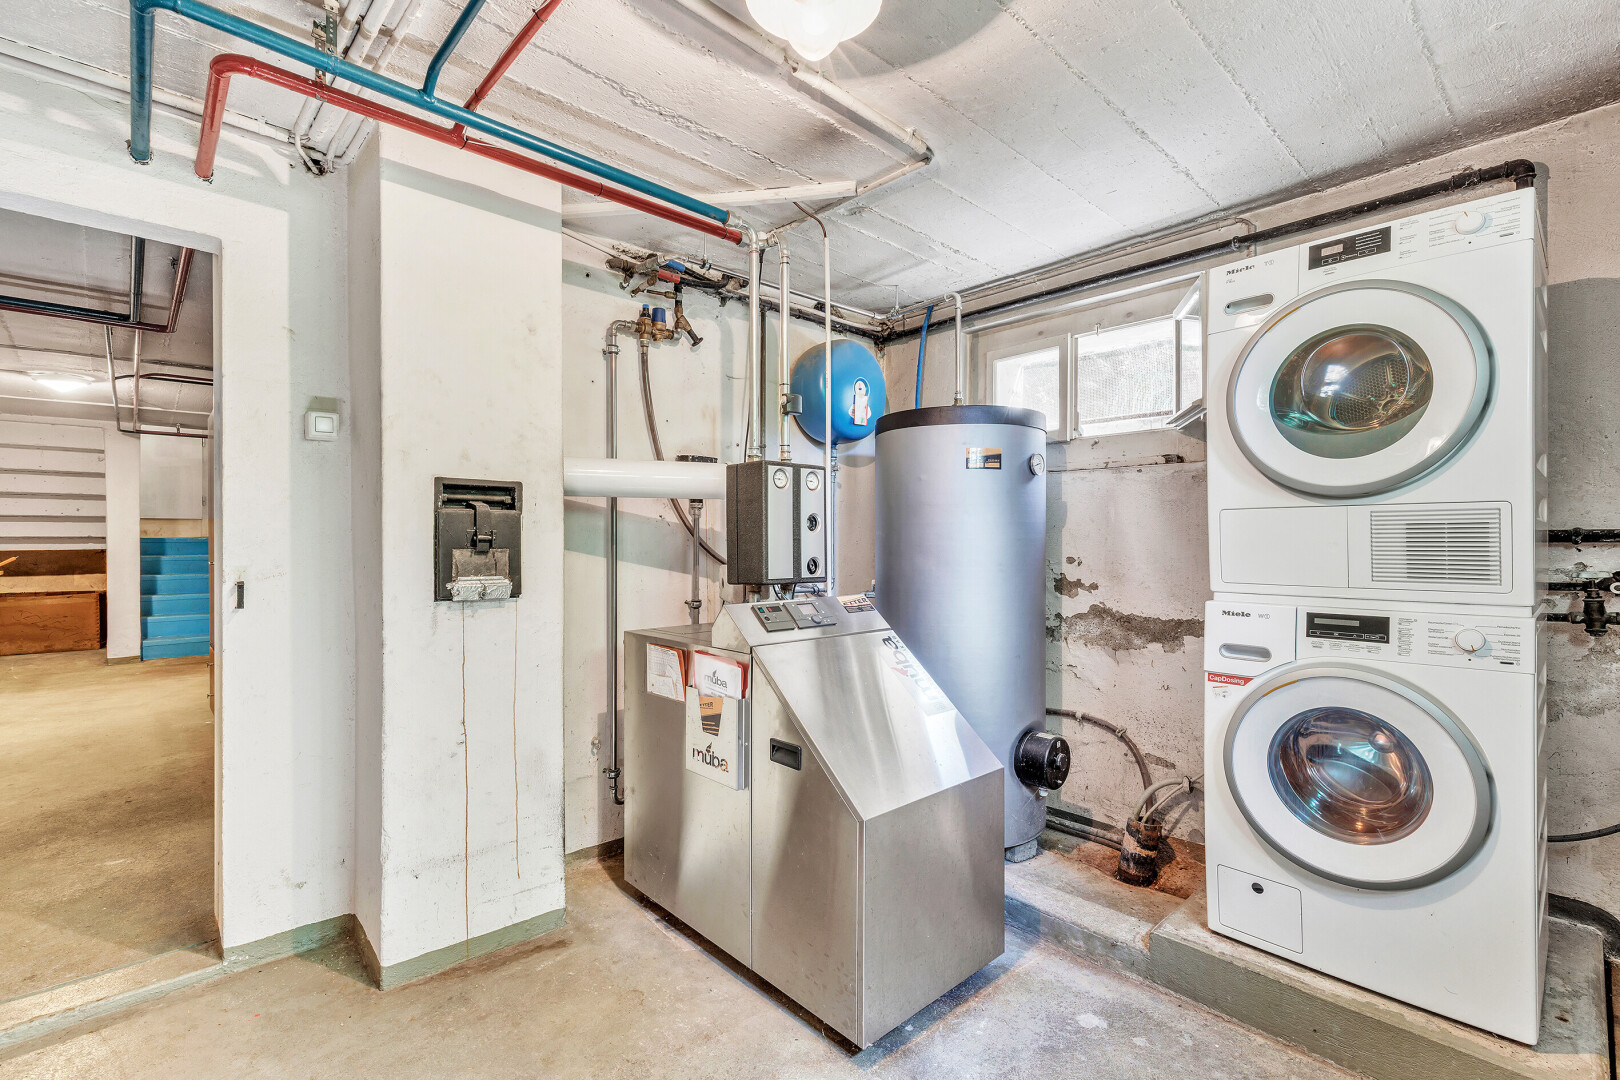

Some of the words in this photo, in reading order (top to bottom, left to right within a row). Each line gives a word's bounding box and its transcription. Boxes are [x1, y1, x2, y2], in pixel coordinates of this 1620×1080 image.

[1226, 264, 1256, 276] Miele
[1221, 609, 1251, 618] Miele
[1209, 675, 1245, 686] CapDosing
